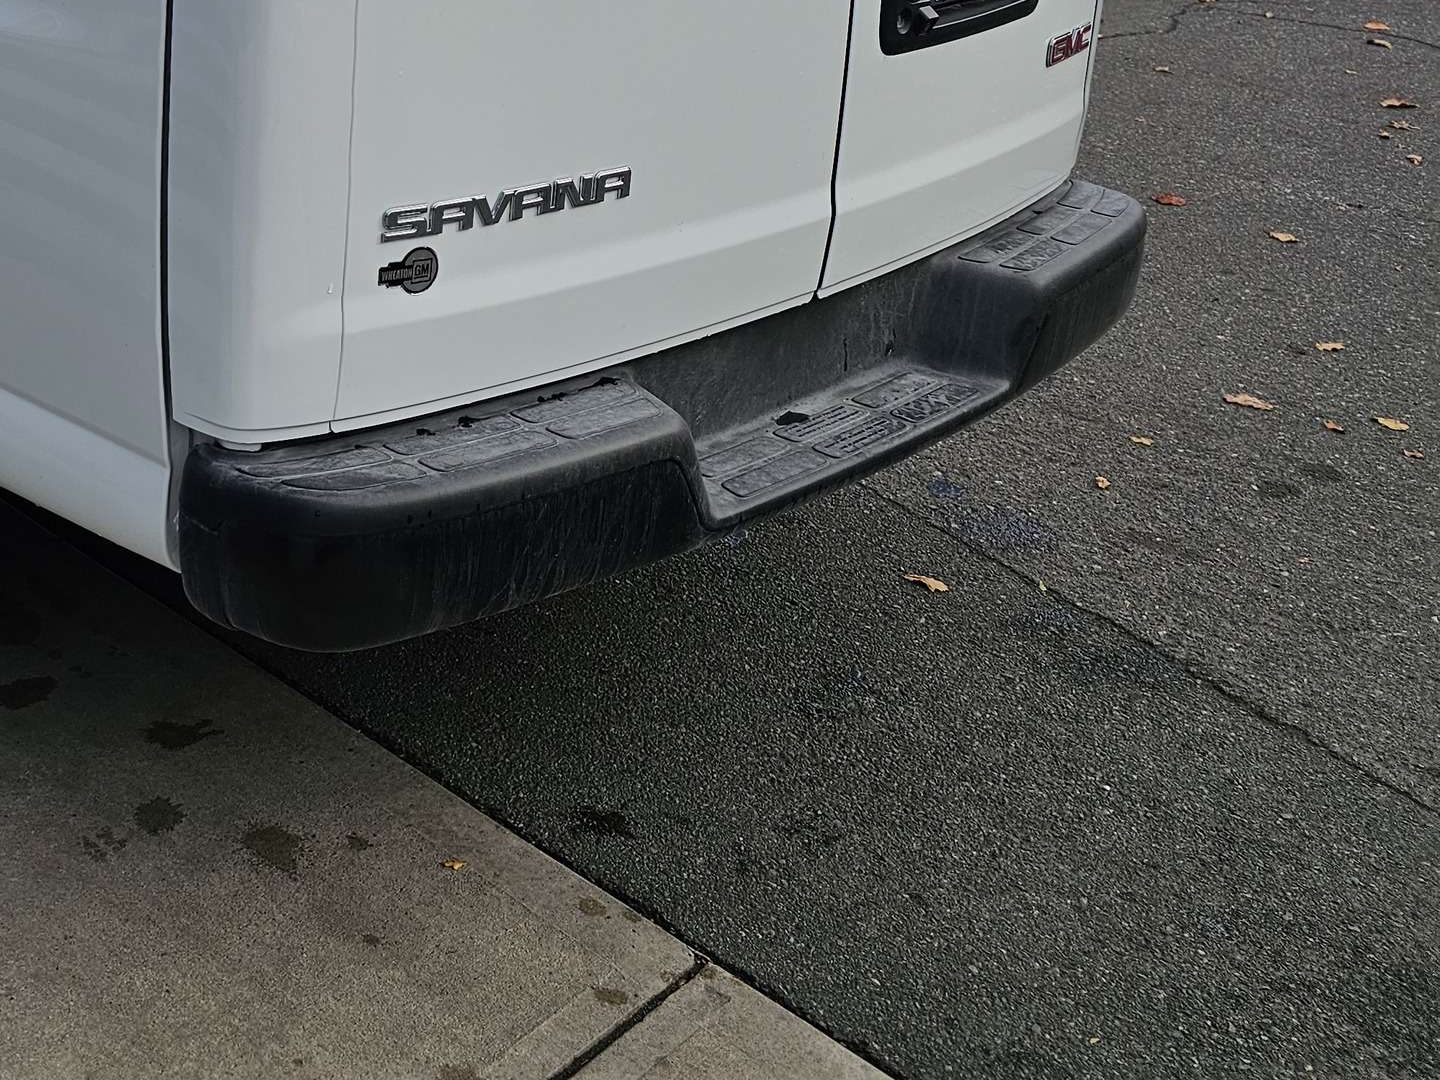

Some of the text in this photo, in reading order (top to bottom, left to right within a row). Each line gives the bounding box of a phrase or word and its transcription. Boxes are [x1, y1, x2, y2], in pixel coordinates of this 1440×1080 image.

[1046, 22, 1092, 68] GMC
[380, 165, 632, 243] SAVANA
[381, 268, 412, 281] WHEATON
